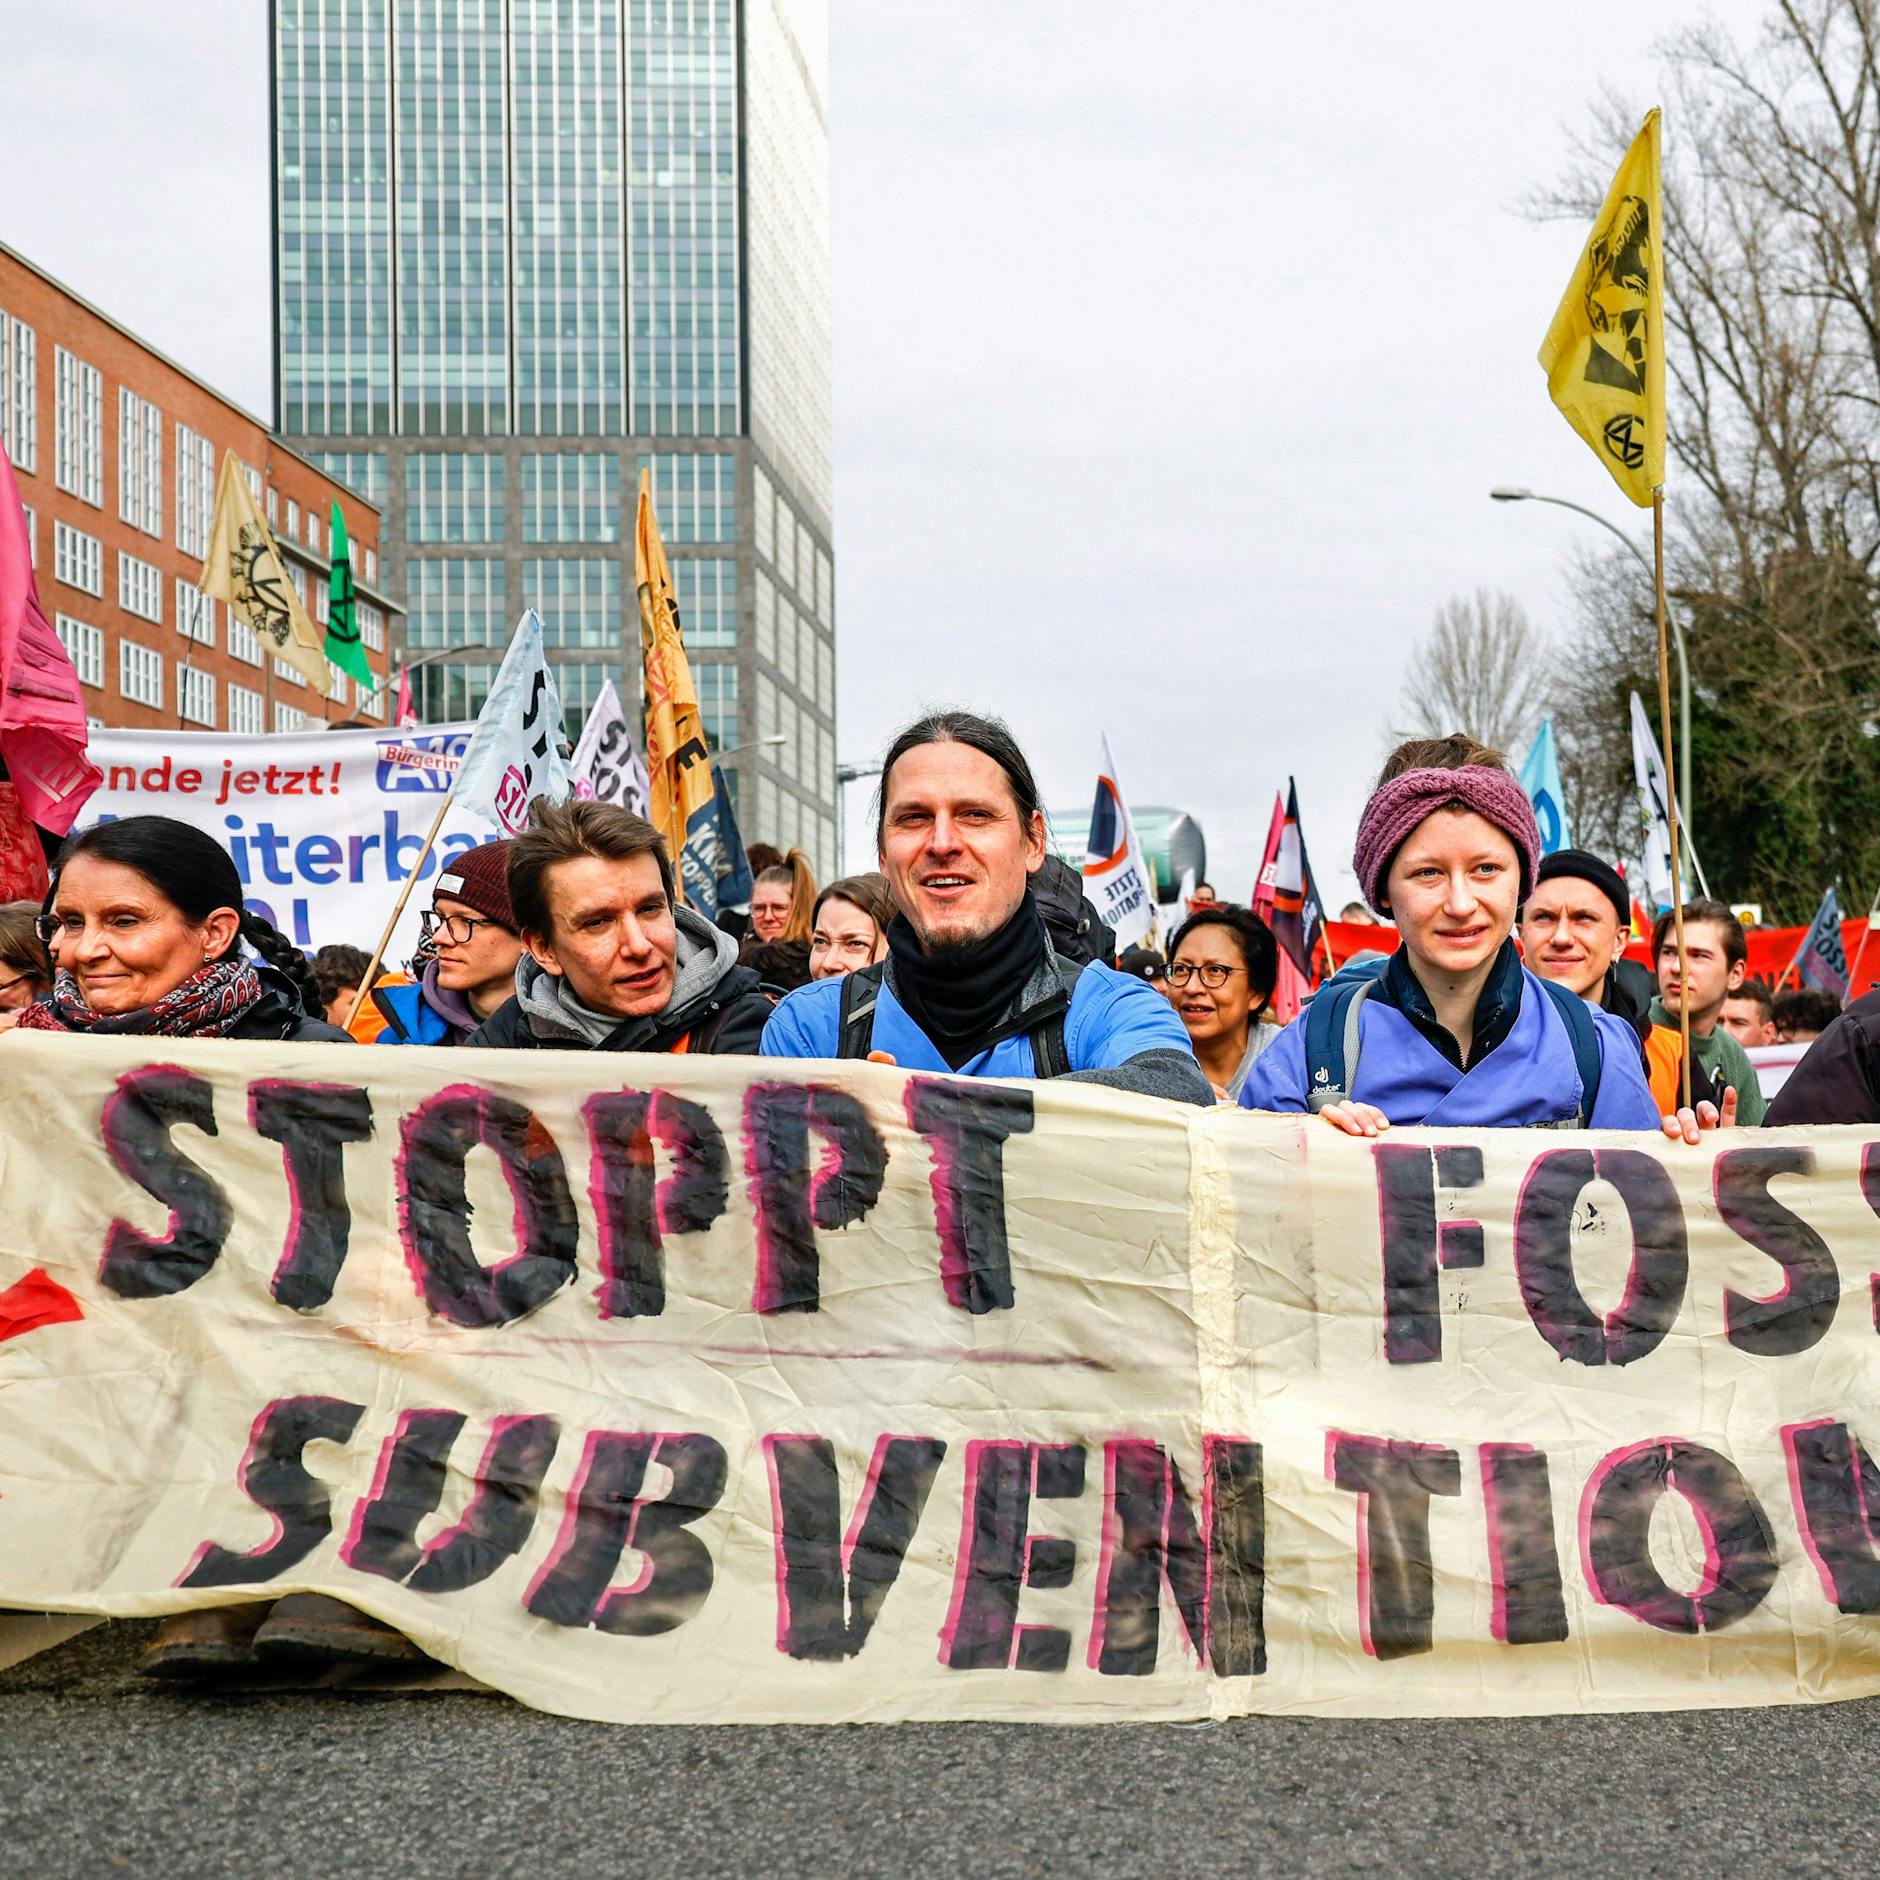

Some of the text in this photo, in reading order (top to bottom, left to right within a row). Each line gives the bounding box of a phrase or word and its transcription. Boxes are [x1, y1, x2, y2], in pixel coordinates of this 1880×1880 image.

[99, 756, 342, 805] nde jetzt!
[1312, 1084, 1341, 1094] deuter
[99, 1063, 1880, 1367] STOPPT FOS
